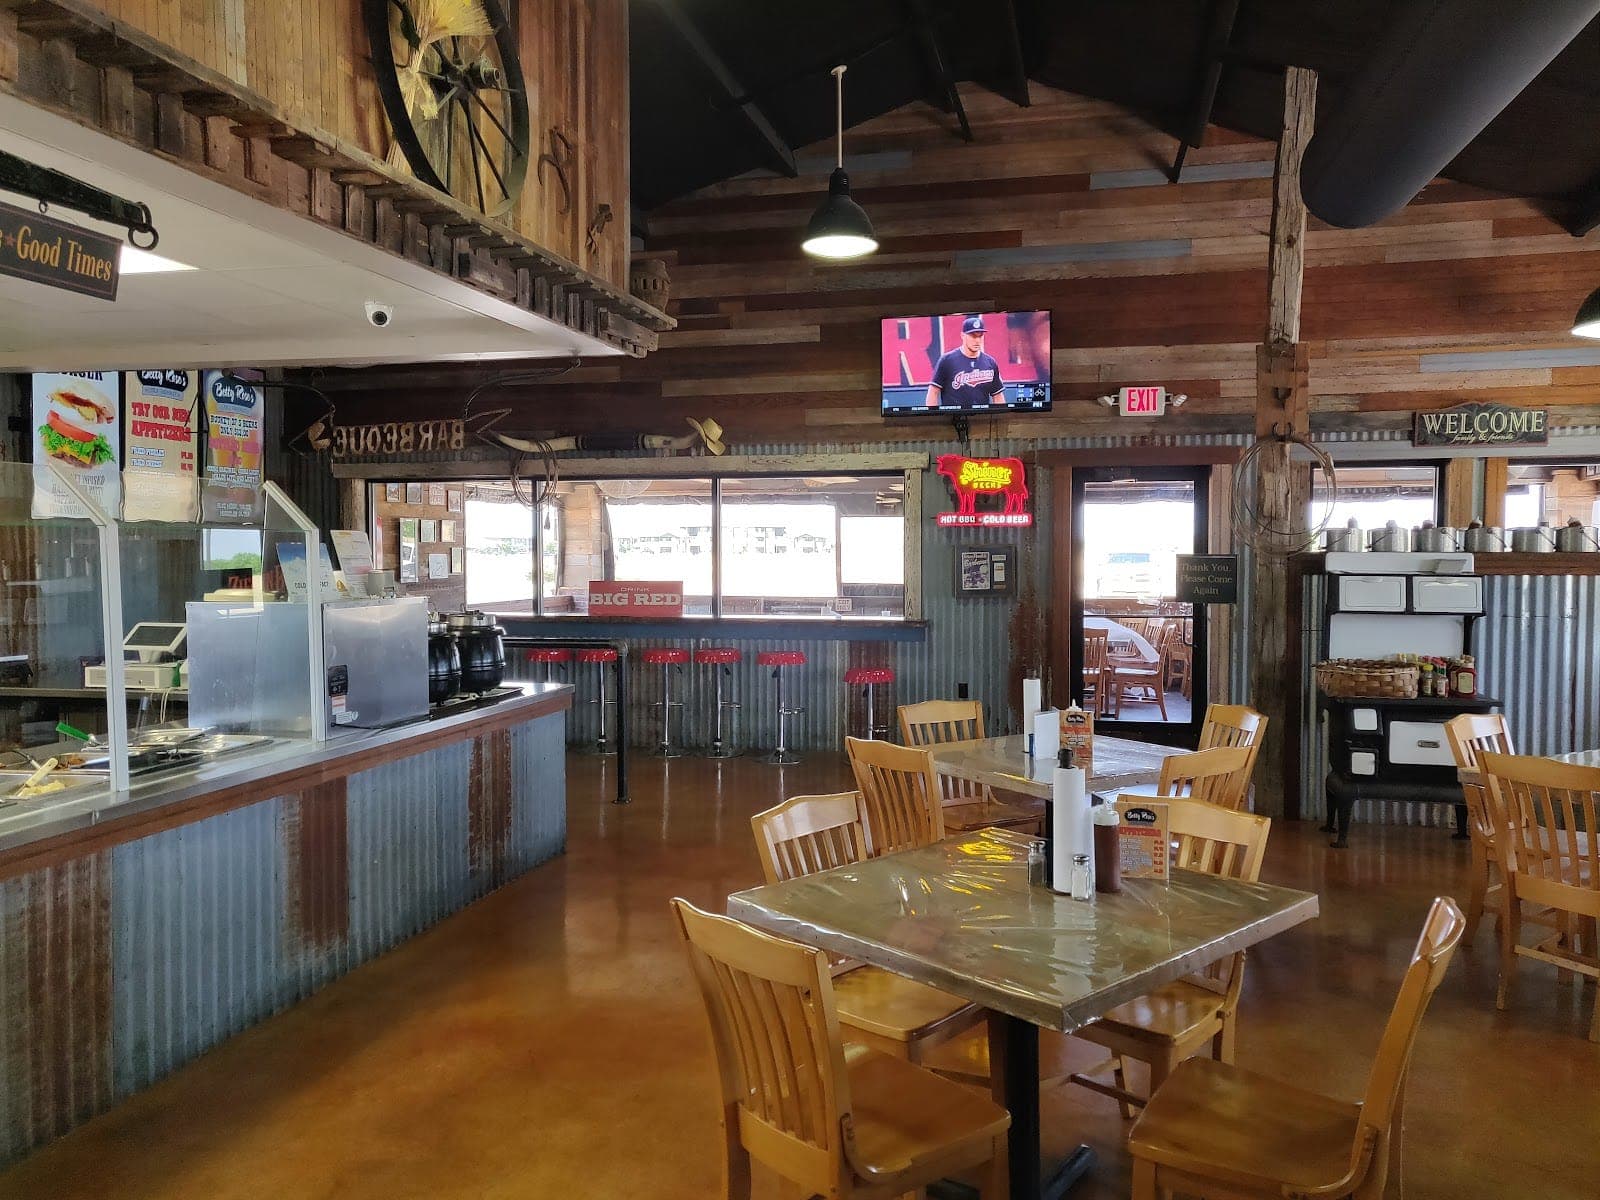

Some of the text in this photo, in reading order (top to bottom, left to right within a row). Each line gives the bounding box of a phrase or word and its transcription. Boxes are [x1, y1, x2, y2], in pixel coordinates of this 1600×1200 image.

[16, 225, 61, 268] Good
[67, 239, 112, 281] Times
[214, 382, 235, 403] Betty
[1127, 388, 1159, 411] EXIT
[131, 402, 150, 417] TRY
[152, 405, 170, 420] OUR
[1422, 410, 1545, 434] WELCOME
[131, 420, 191, 442] APPETIZERS
[959, 460, 1012, 485] Shiner
[940, 515, 957, 523] HOT
[983, 514, 1006, 524] COLD
[1006, 515, 1029, 523] BEER
[589, 592, 682, 606] BIG RED
